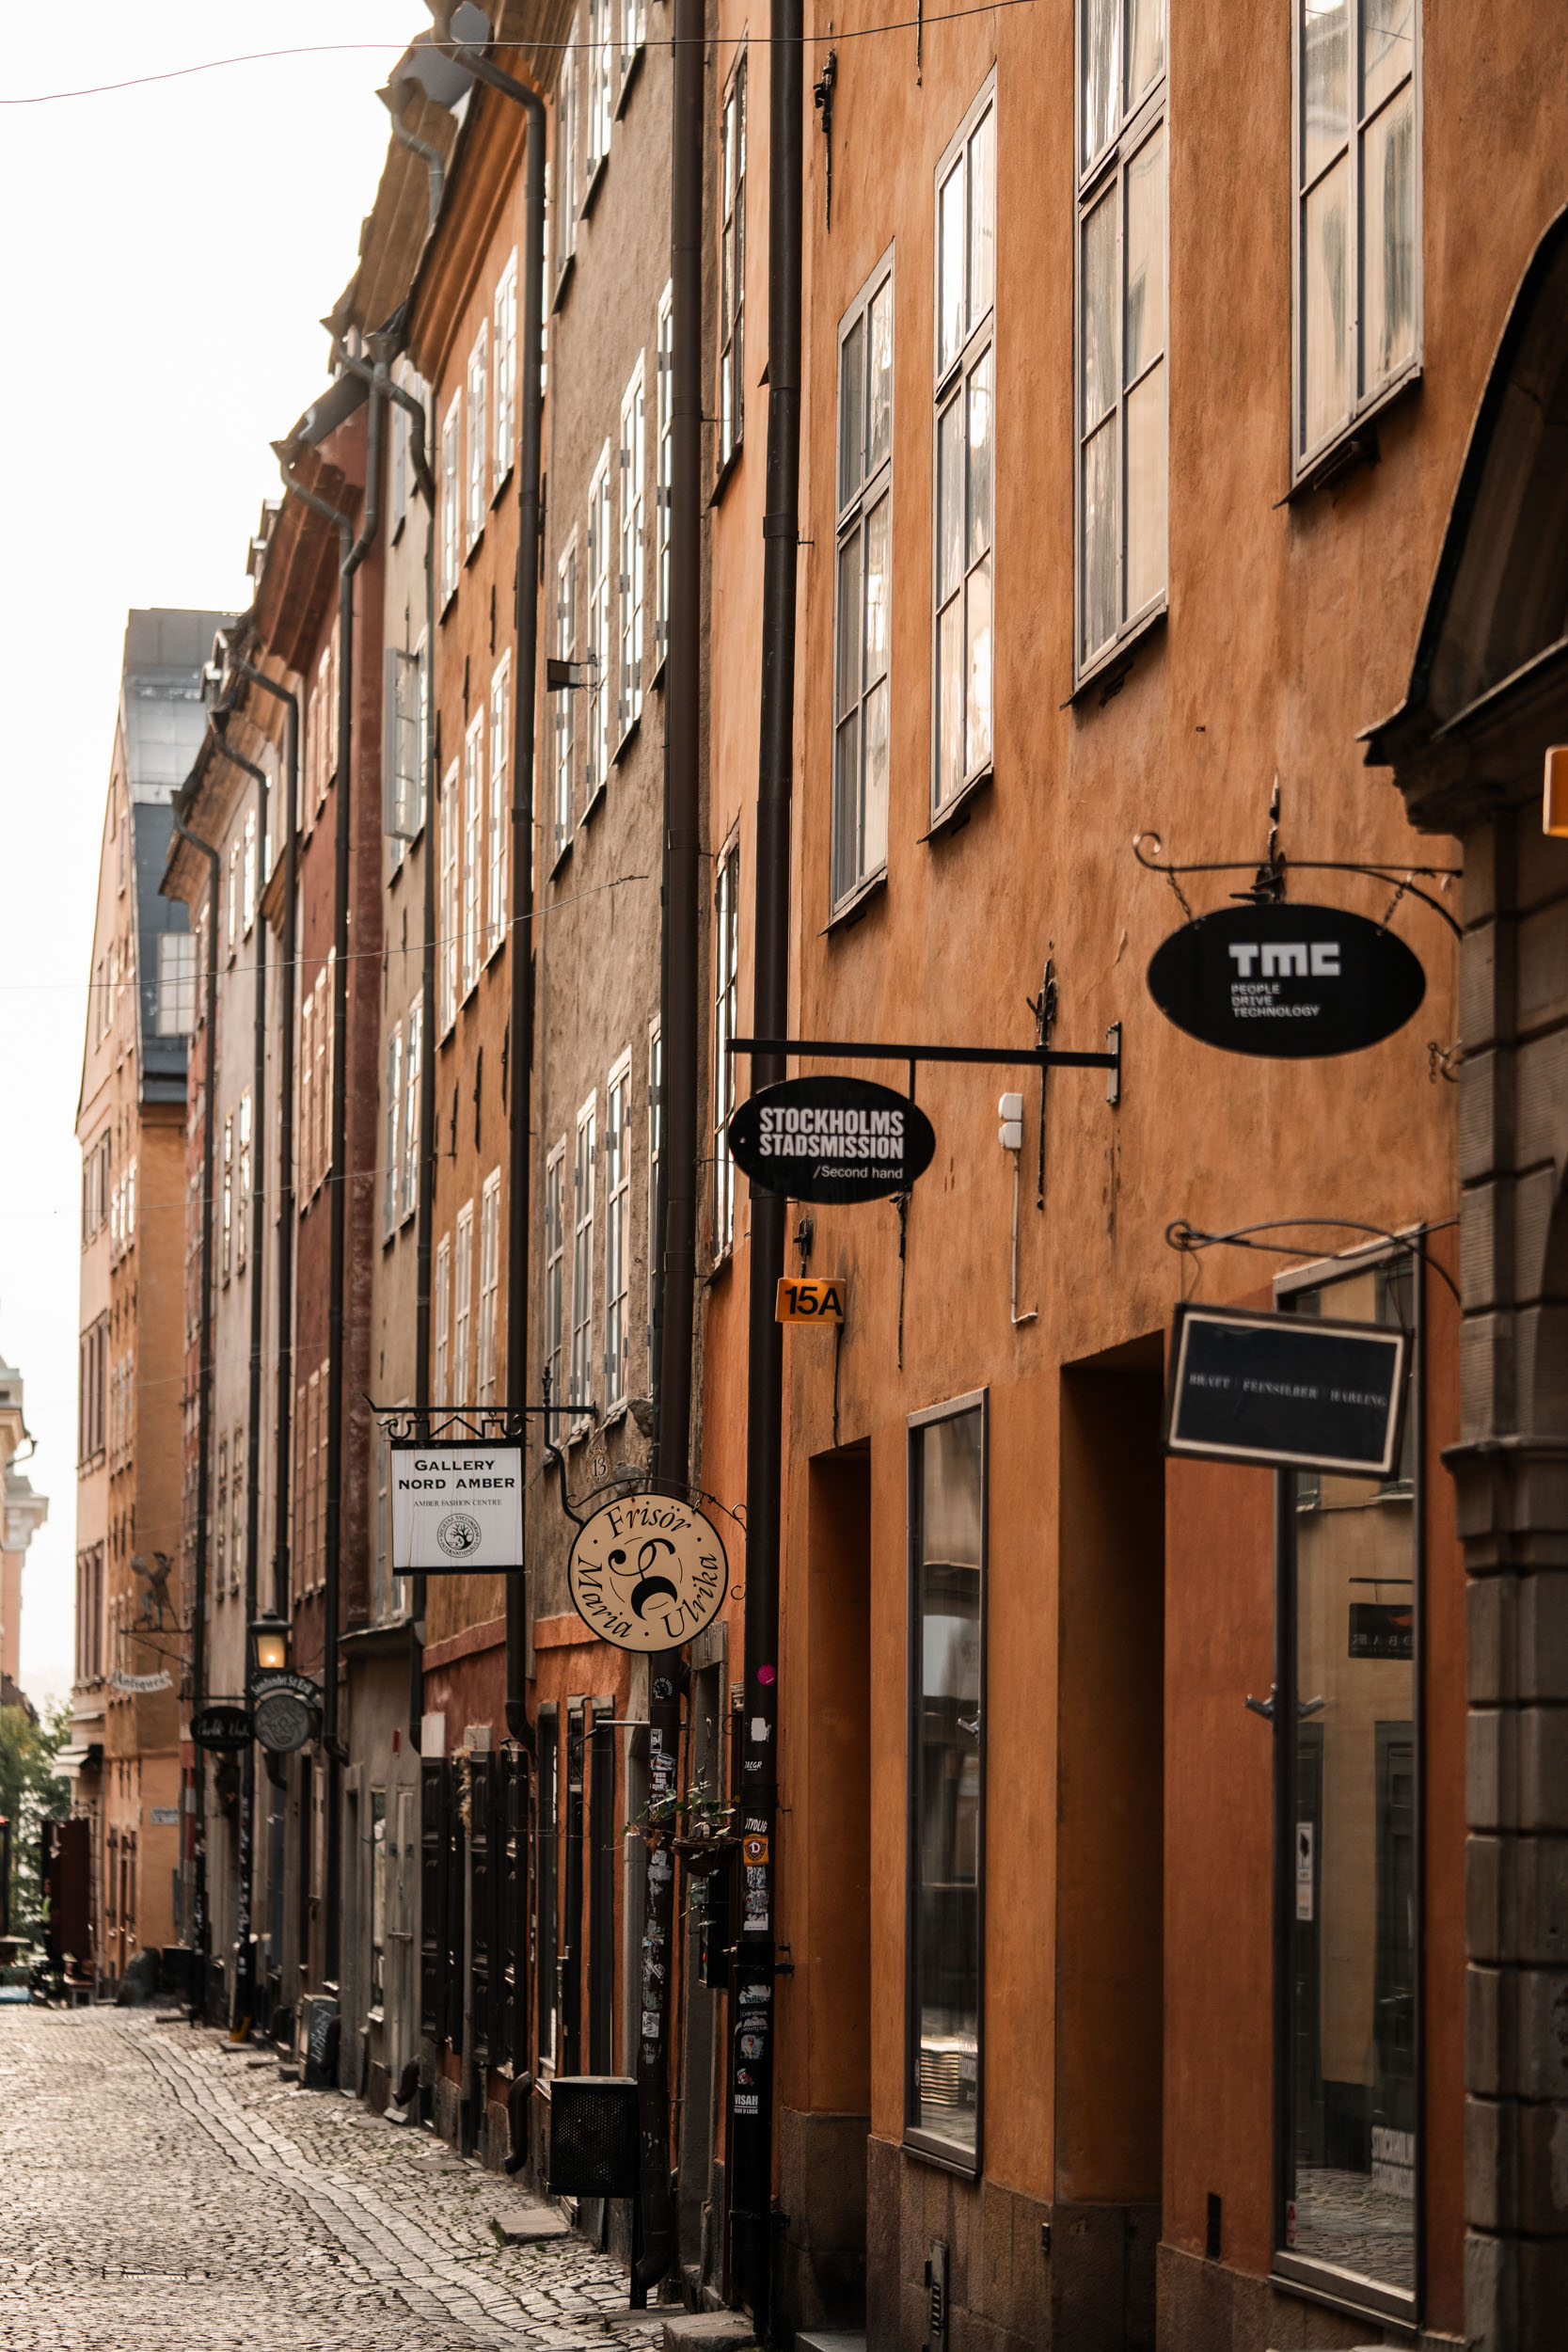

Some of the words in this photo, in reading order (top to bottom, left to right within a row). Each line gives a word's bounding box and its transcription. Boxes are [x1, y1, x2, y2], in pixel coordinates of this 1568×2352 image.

[1228, 943, 1341, 978] TMC
[1231, 982, 1281, 995] PEOPLE
[1231, 995, 1274, 1007] DRIVE
[1232, 1005, 1321, 1019] TECHNOLOGY
[759, 1107, 905, 1137] STOCKHOLMS
[759, 1134, 905, 1160] STADSMISSION
[872, 1167, 904, 1180] hand
[784, 1286, 844, 1316] 15A
[415, 1460, 495, 1471] GALLERY
[399, 1479, 447, 1489] NORD
[455, 1478, 515, 1488] AMBER
[604, 1502, 691, 1539] Frisör
[578, 1554, 633, 1638] Maria
[660, 1553, 719, 1638] Ulrika
